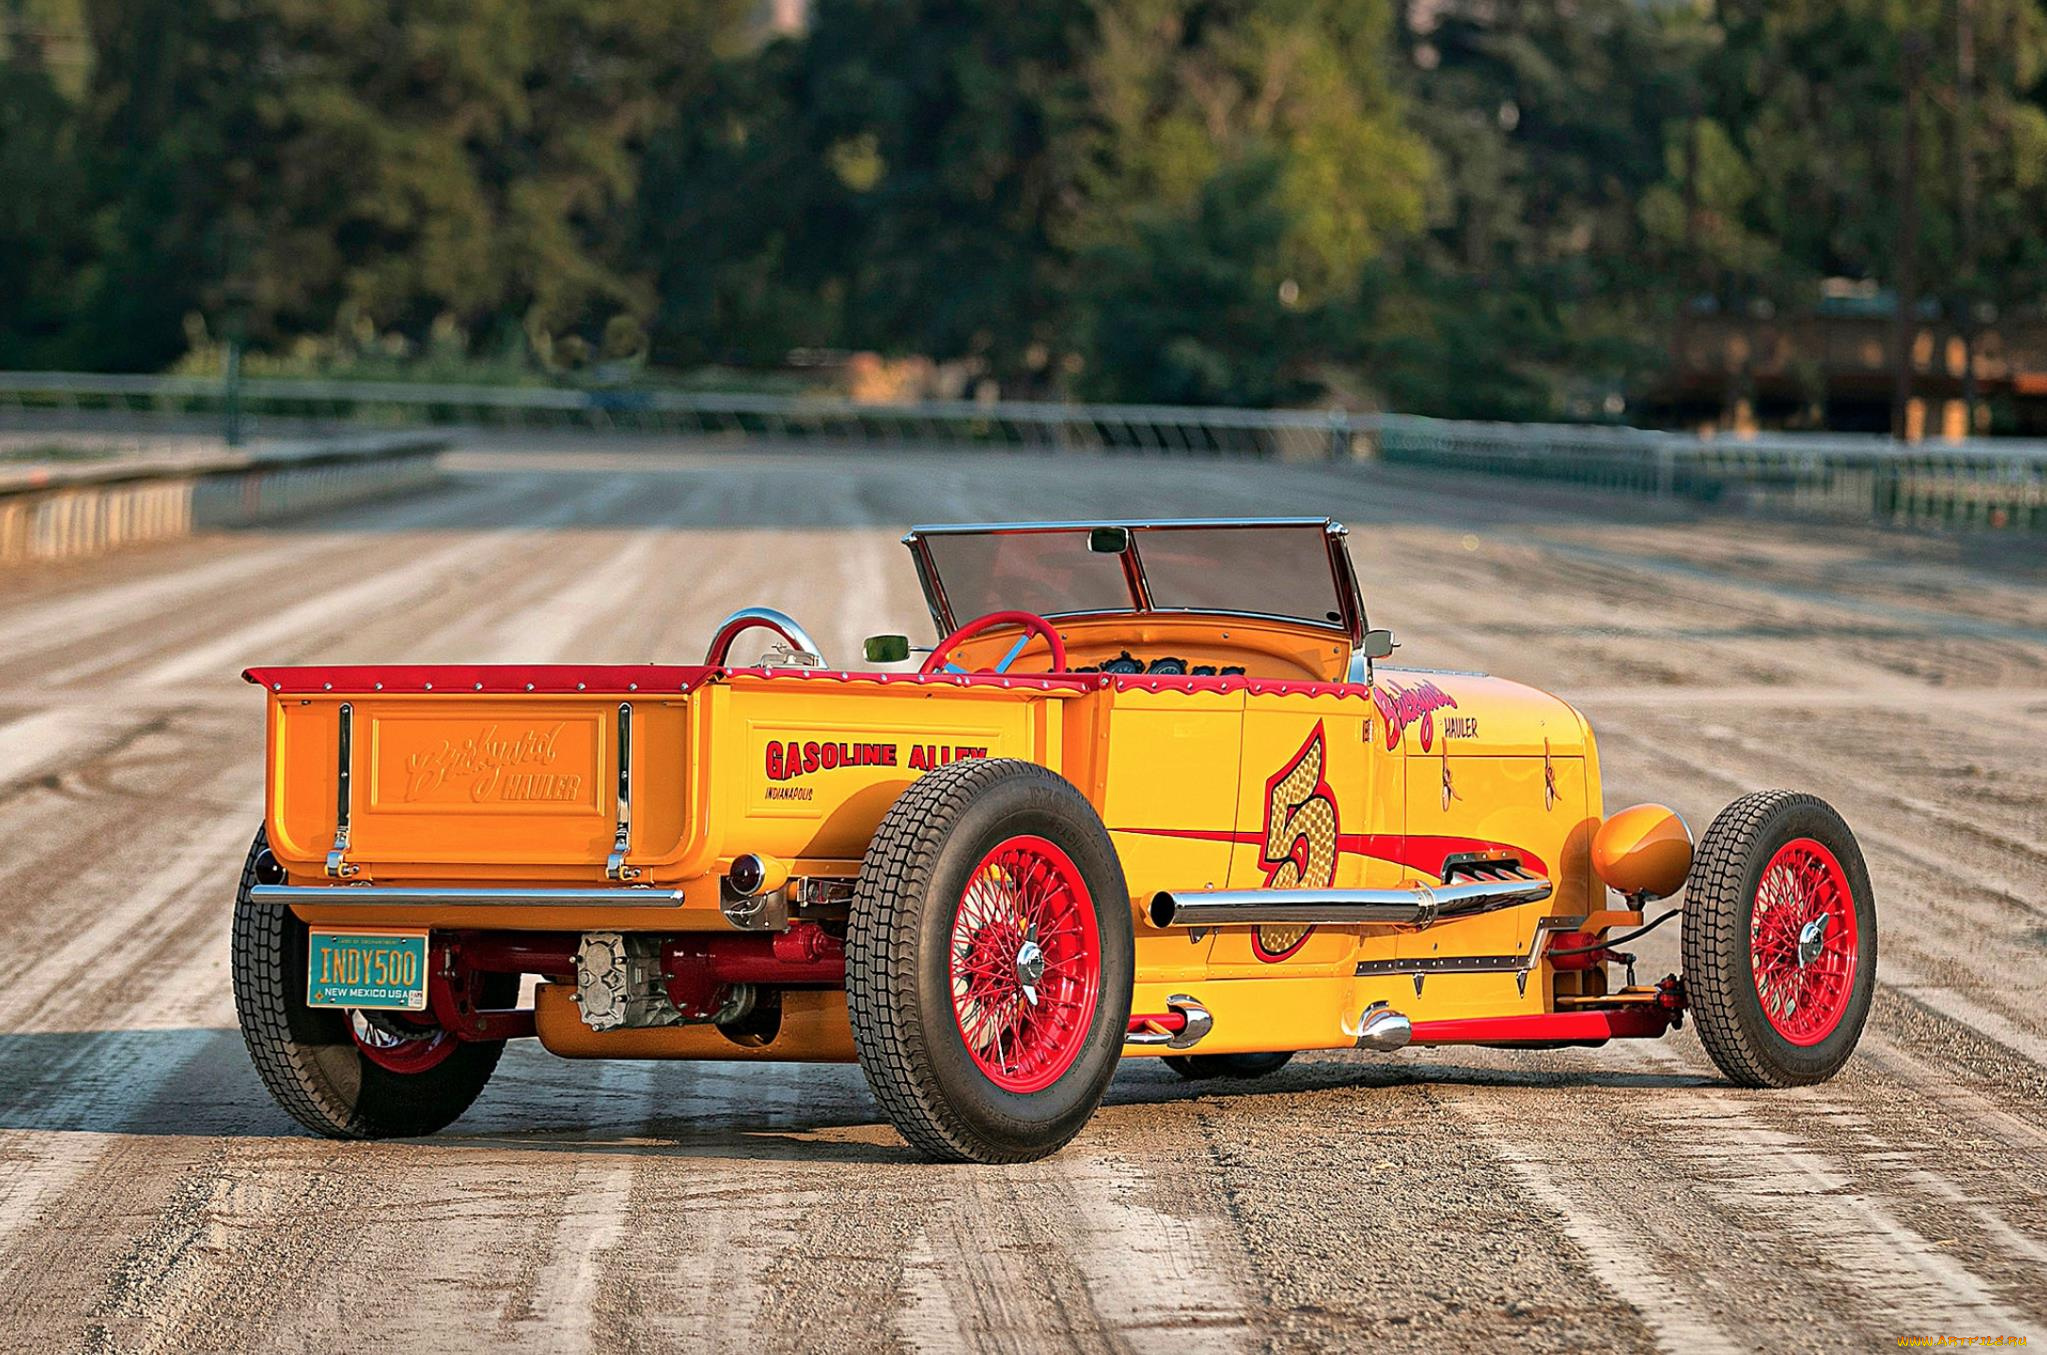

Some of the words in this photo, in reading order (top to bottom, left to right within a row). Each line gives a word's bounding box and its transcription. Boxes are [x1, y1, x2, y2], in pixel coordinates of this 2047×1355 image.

[1443, 717, 1479, 738] HAULER
[765, 740, 897, 781] GASOLINE
[501, 773, 582, 801] HAULER
[764, 786, 813, 801] INDIANAPOLIS
[319, 947, 416, 986] INDY500
[324, 987, 348, 997] NEW
[349, 988, 386, 998] MEXICO
[387, 988, 408, 999] USA
